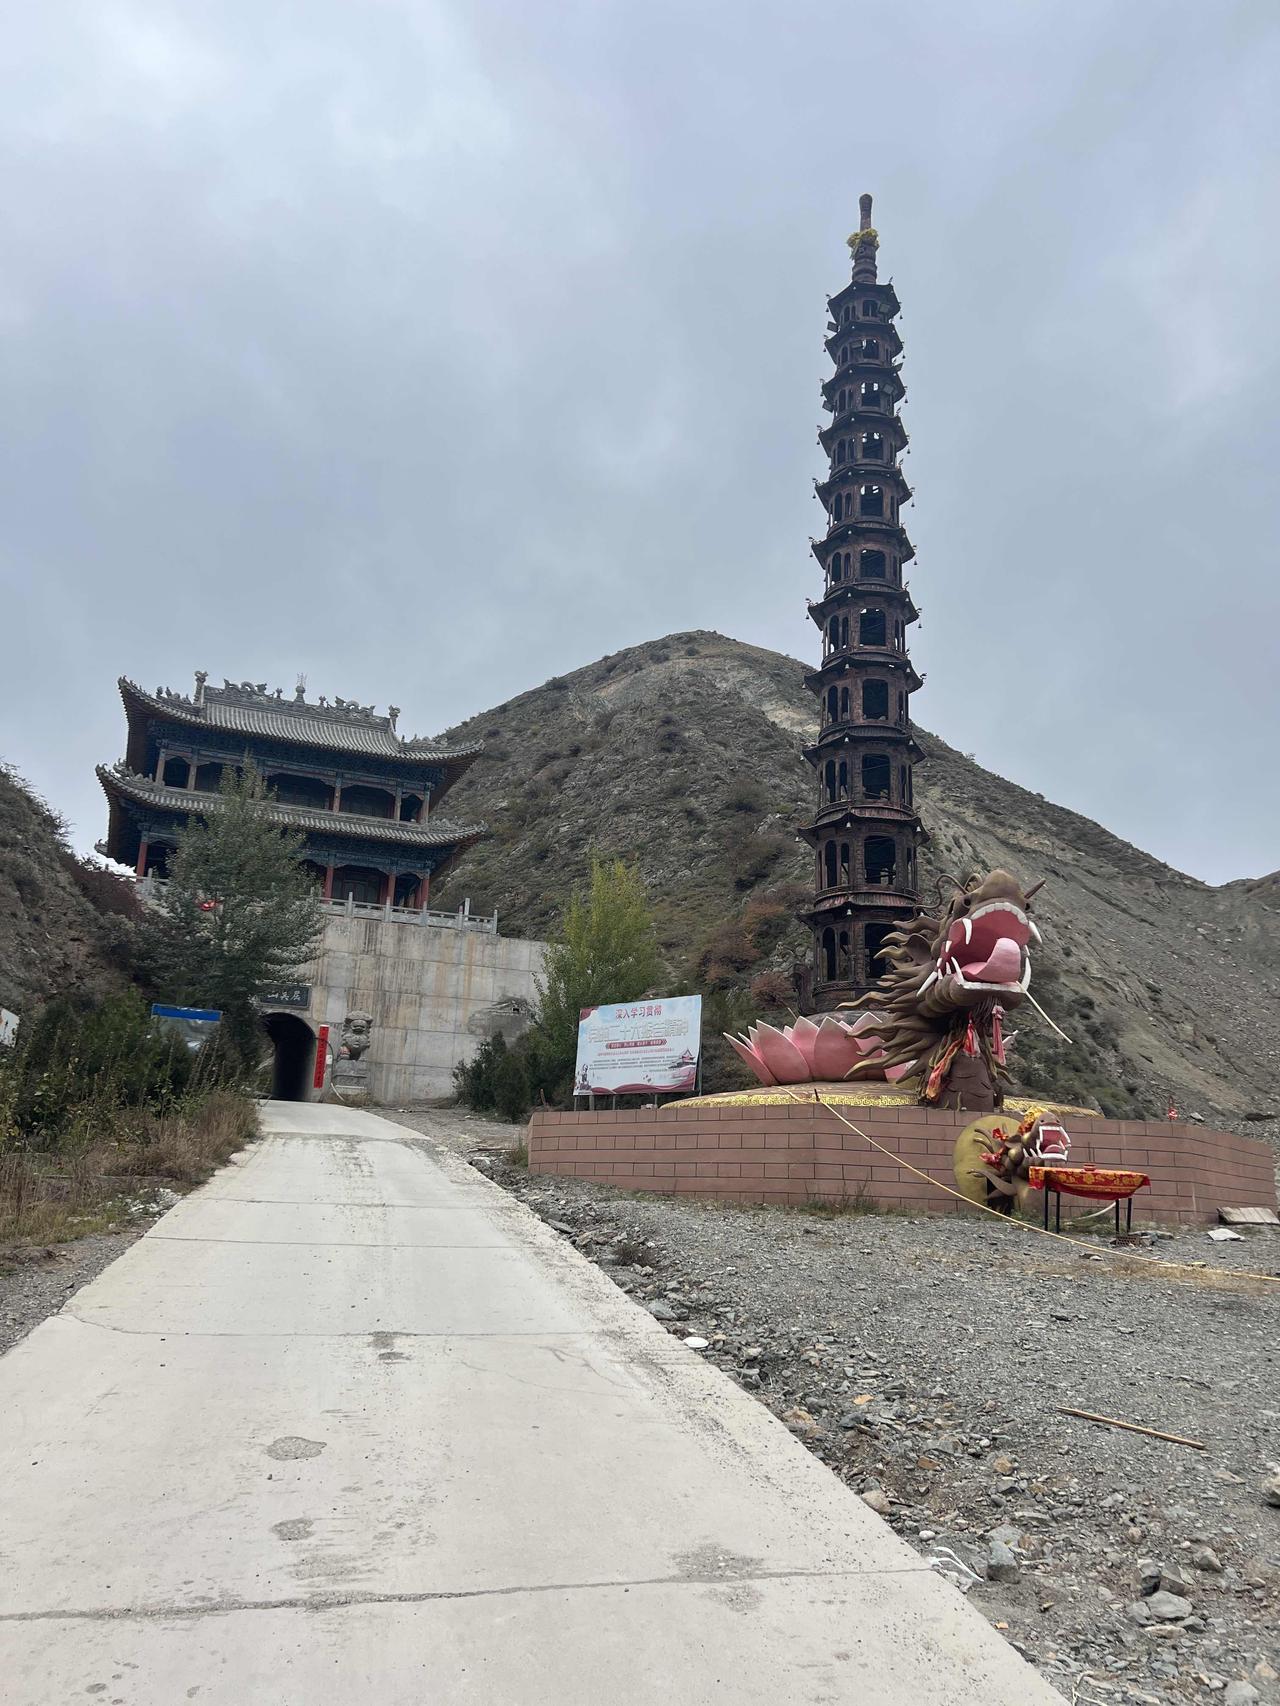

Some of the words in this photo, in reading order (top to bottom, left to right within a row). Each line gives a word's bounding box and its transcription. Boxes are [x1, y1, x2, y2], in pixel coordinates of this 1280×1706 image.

[615, 1005, 662, 1019] 深入学习贯彻
